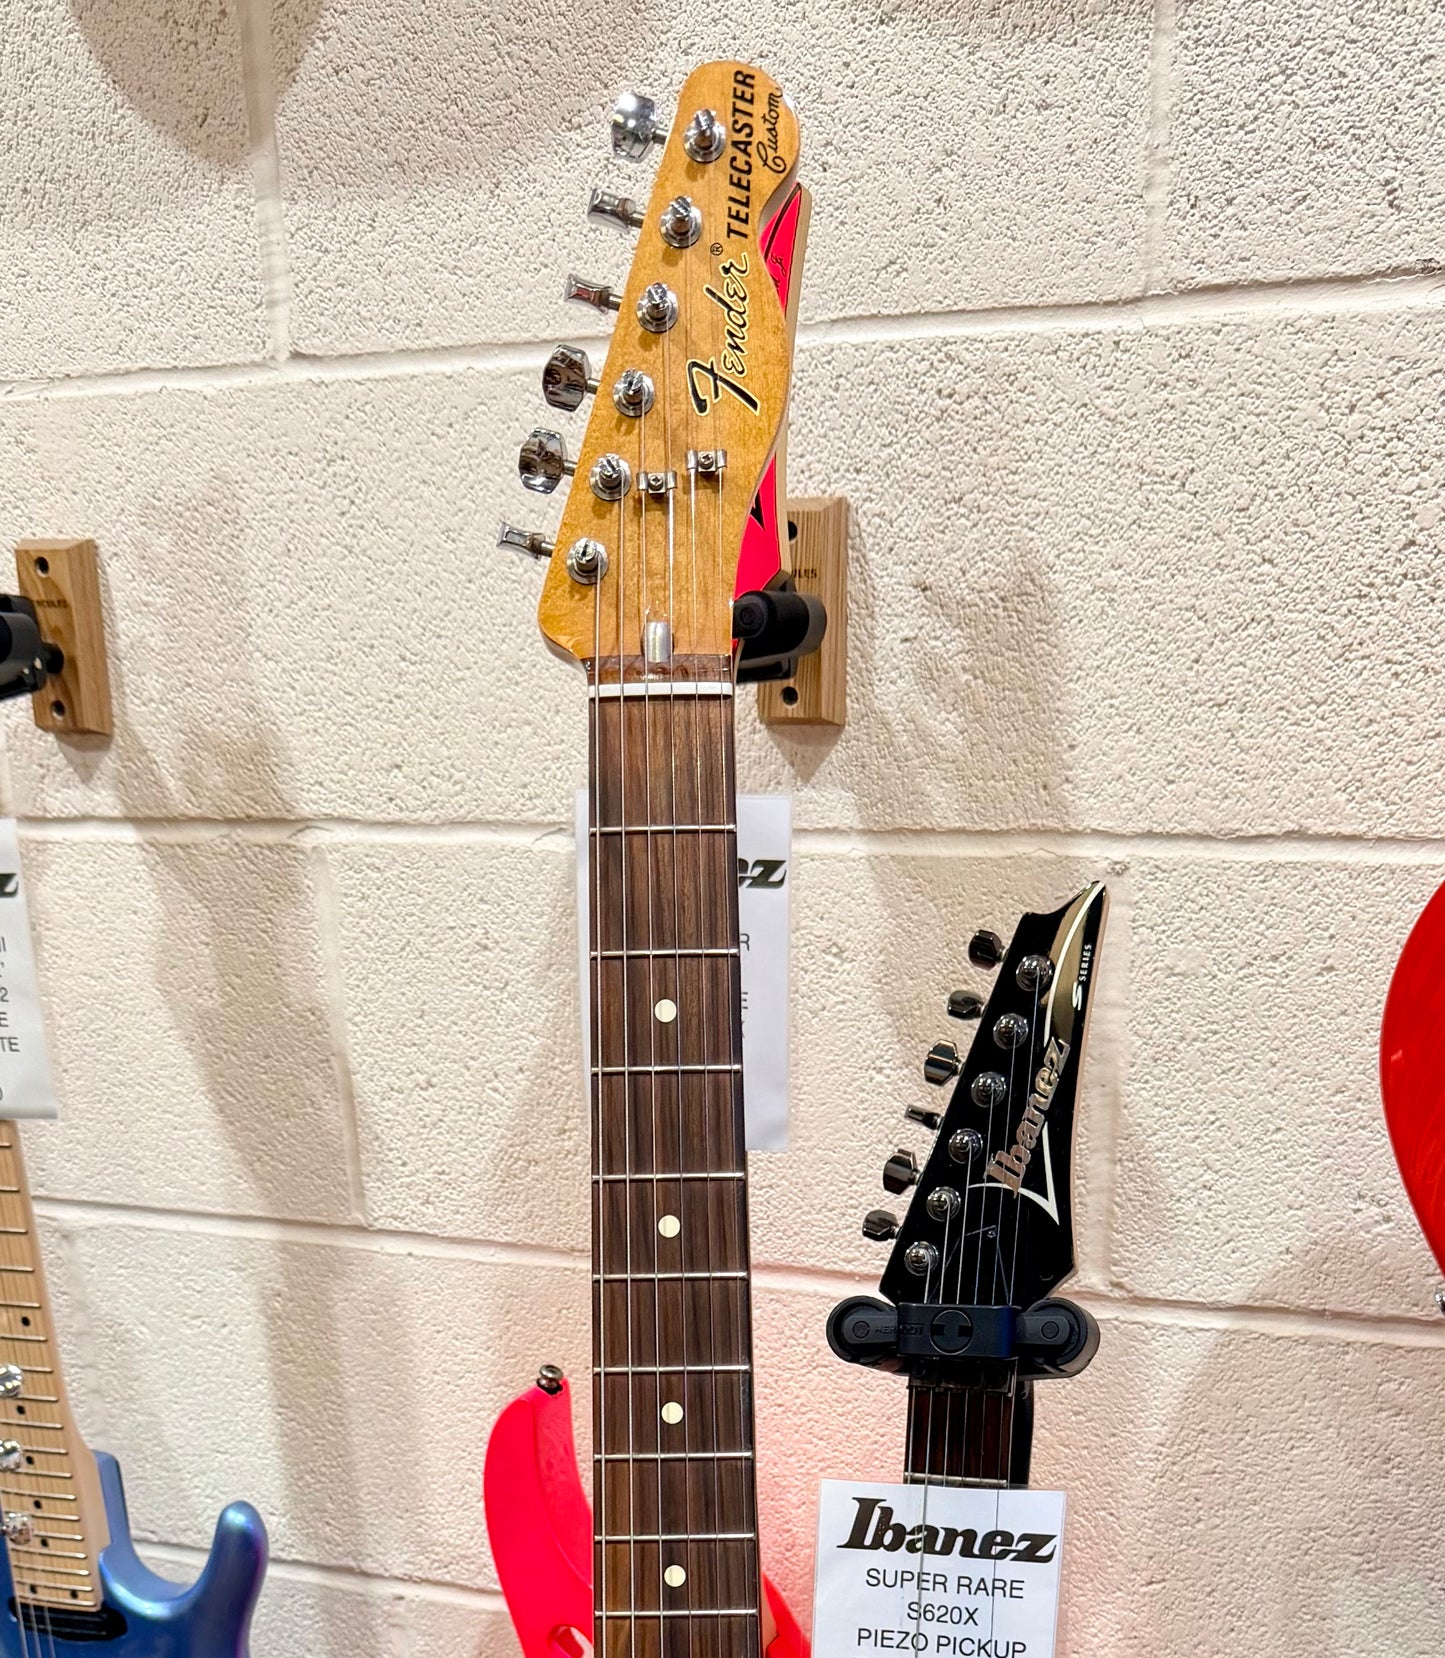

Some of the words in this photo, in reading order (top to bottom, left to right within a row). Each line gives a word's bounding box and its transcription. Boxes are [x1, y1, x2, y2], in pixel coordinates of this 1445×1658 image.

[727, 70, 755, 239] TELECASTER
[756, 87, 787, 174] Custom
[686, 252, 761, 417] Fender
[1079, 944, 1092, 981] SERIES
[983, 1036, 1070, 1199] Ibanez
[836, 1497, 1057, 1563] Ibanez
[866, 1568, 948, 1593] SUPER
[957, 1576, 1025, 1599] RARE
[907, 1601, 979, 1626] S620X
[857, 1628, 928, 1651] PIEZO
